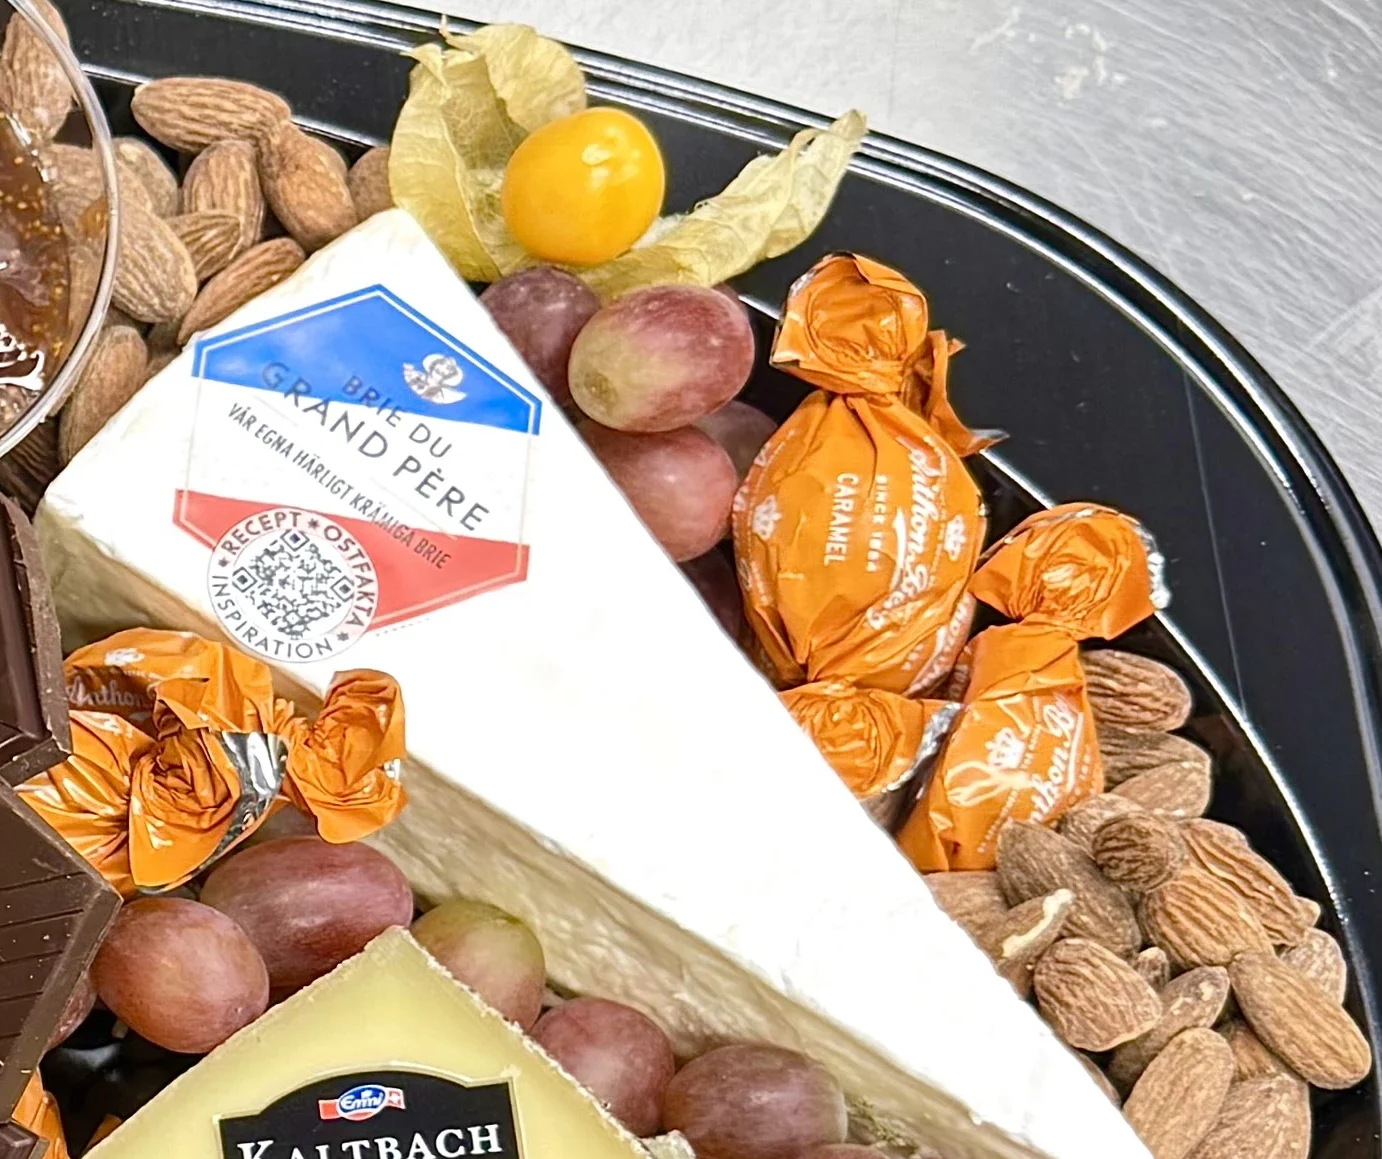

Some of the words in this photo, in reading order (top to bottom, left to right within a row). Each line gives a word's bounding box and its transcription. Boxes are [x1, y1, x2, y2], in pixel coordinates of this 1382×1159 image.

[261, 362, 388, 459] GRAND
[392, 454, 490, 532] PÈRE
[342, 375, 406, 428] BRIE
[408, 422, 453, 459] DU
[228, 402, 256, 432] VÅR
[254, 423, 293, 459] EGNA
[293, 445, 353, 501] HÄRLIGT
[349, 490, 415, 548] KRÄMIGA
[414, 537, 453, 570] BRIE
[823, 472, 859, 566] CARAMEL
[212, 575, 334, 660] INSPIRATION
[221, 510, 301, 556] RECEPT
[323, 525, 375, 635] OSTFAKTA
[1029, 747, 1070, 825] nthon
